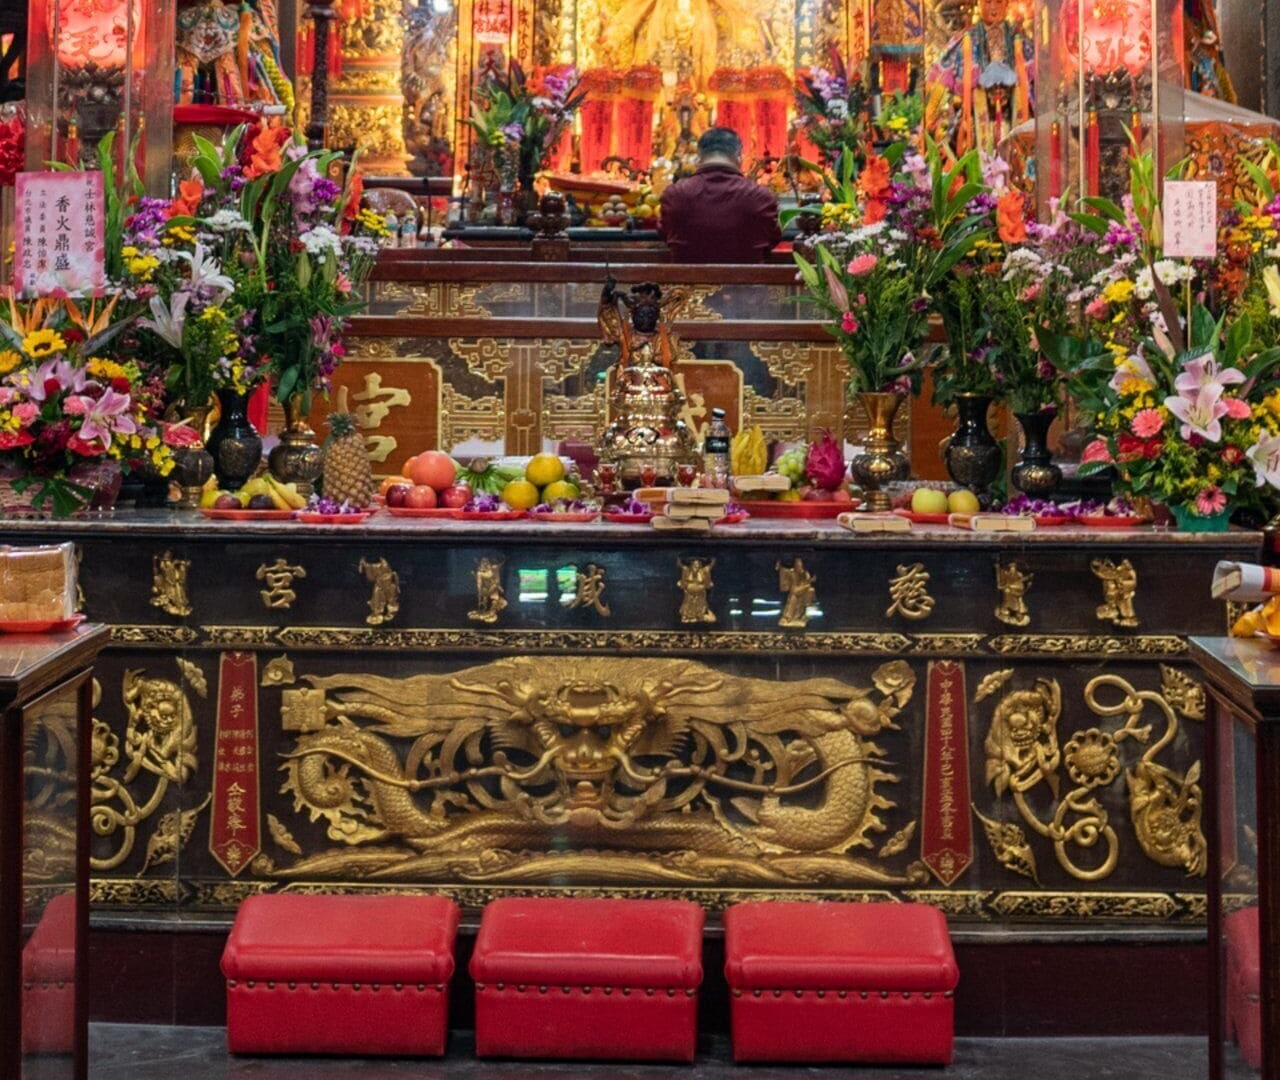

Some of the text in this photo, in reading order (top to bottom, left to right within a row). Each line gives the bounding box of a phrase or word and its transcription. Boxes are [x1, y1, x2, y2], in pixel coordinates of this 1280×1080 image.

[54, 194, 72, 272] 香火鼎盛
[336, 371, 411, 463] 宮
[254, 557, 306, 610] 宮
[886, 563, 936, 621] 慈
[229, 686, 246, 719] 弟子
